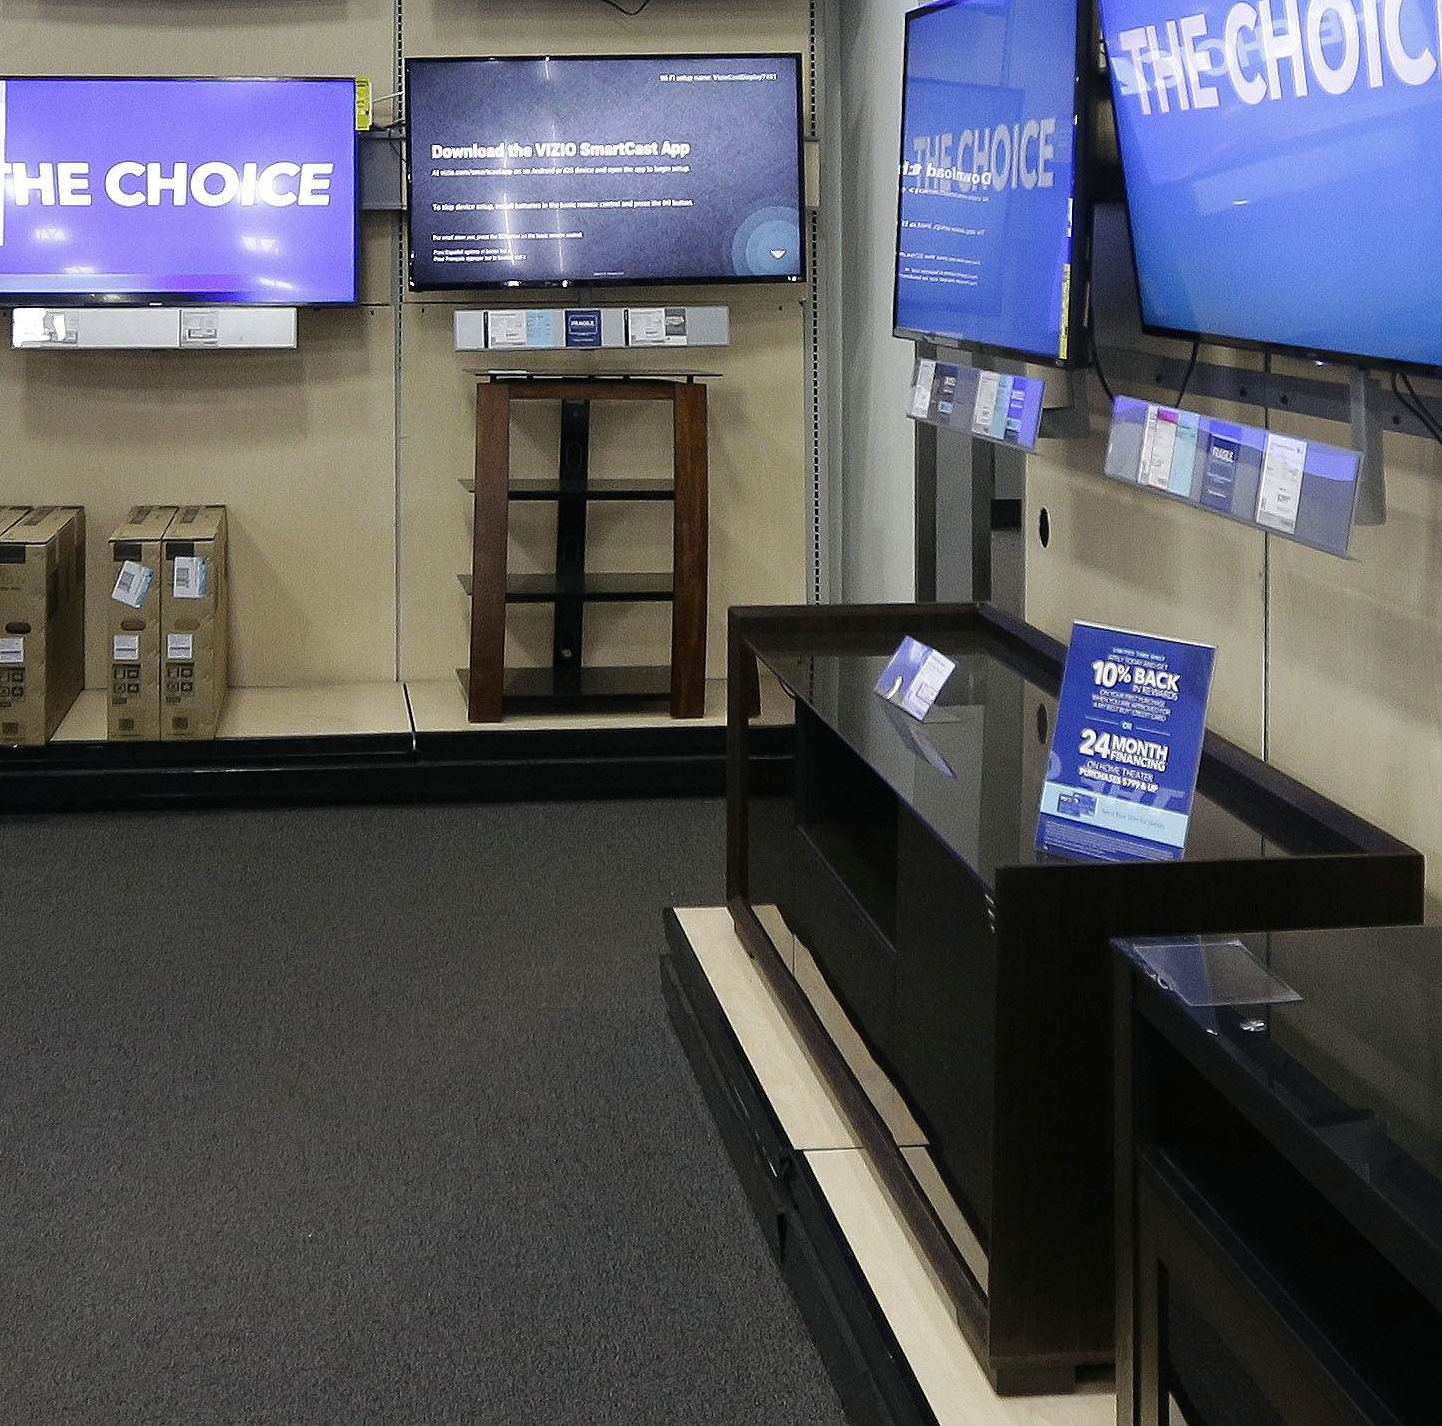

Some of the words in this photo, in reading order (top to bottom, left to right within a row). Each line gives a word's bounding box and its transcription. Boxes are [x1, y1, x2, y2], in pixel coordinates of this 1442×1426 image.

[1119, 14, 1220, 115] THE
[431, 142, 505, 159] Download
[507, 142, 533, 158] the
[535, 142, 577, 158] VIZIO
[579, 141, 659, 157] SmartCast
[661, 140, 690, 158] App
[913, 132, 954, 192] THE
[957, 118, 1055, 192] CHOICE
[0, 162, 93, 207] HE
[105, 162, 334, 207] CHOICE
[1092, 659, 1132, 688] 10%
[1133, 667, 1181, 693] BACK
[1121, 720, 1133, 732] OR
[1079, 728, 1110, 759] 24
[1110, 735, 1170, 762] MONTH
[1109, 750, 1167, 773] FINANCING
